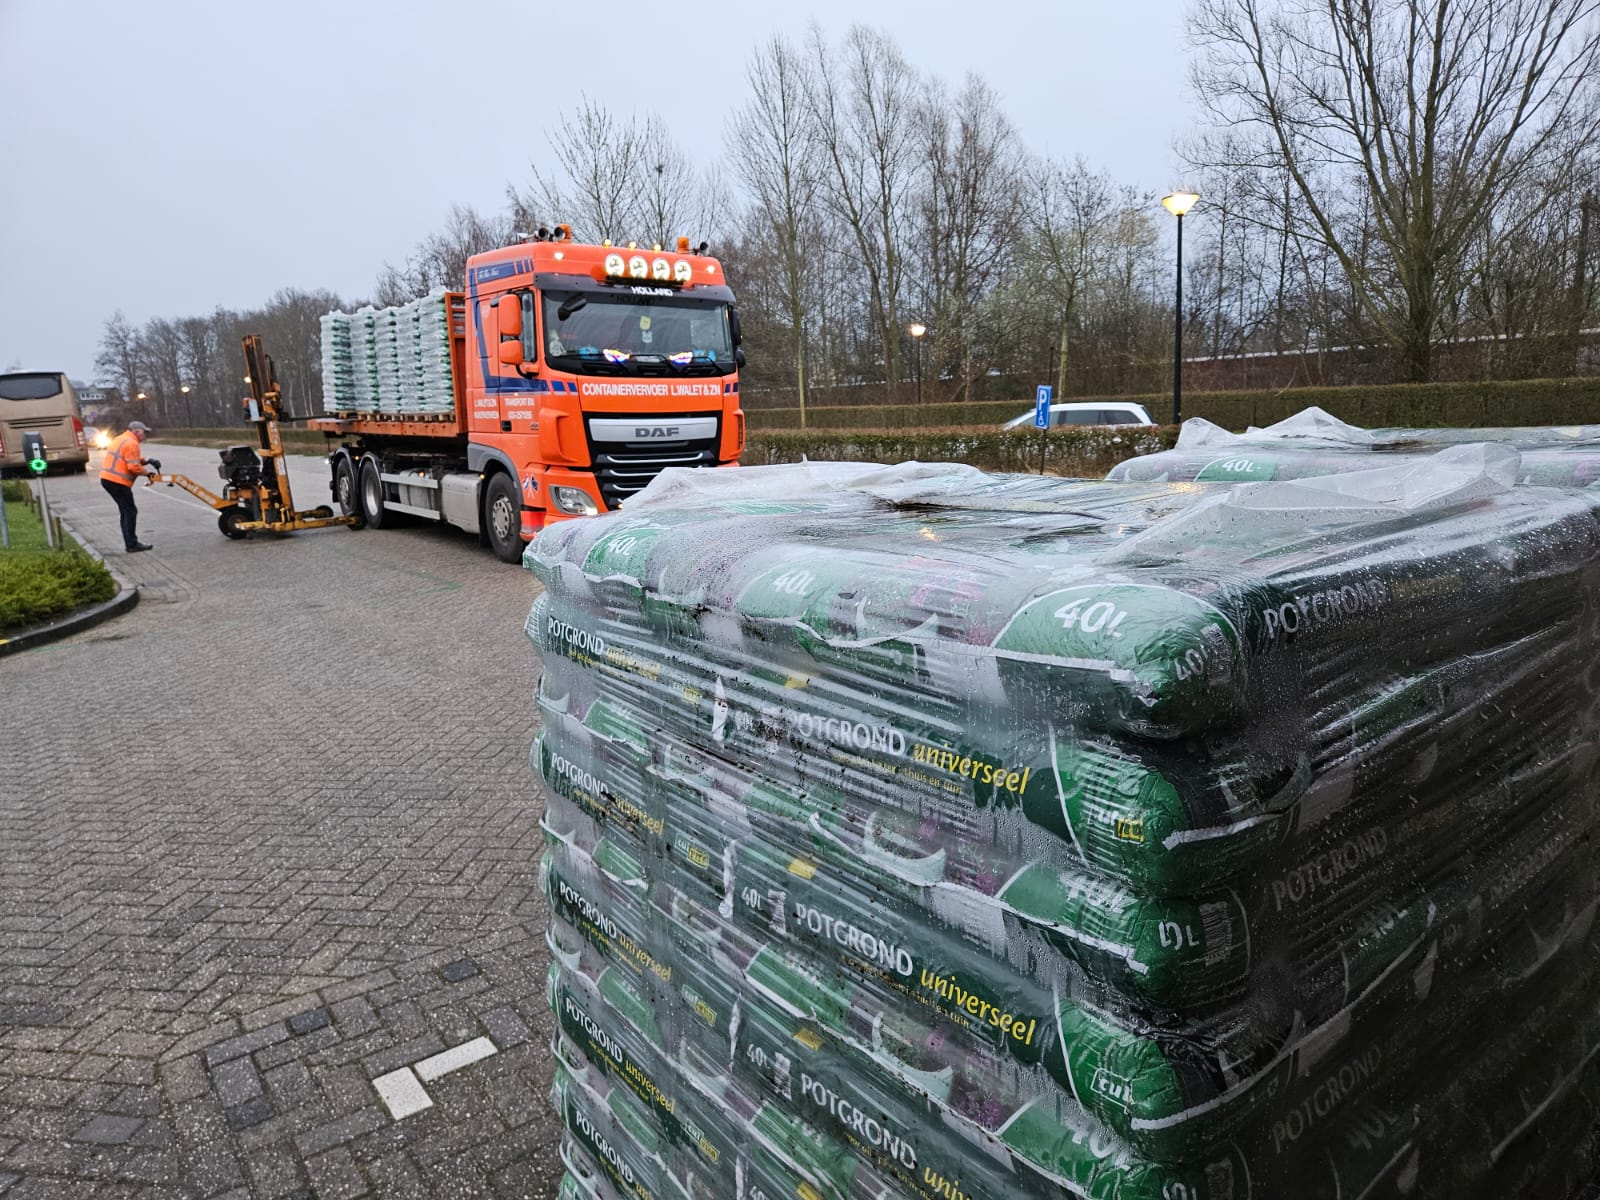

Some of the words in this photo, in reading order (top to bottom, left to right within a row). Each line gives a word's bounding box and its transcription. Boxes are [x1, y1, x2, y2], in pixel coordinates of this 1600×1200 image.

[631, 286, 674, 297] HOLLAND
[582, 383, 668, 396] CONTAINERVERVOER
[1039, 389, 1048, 411] P
[635, 427, 680, 438] DAF
[1222, 459, 1254, 473] 40L
[607, 536, 638, 556] 40L
[772, 569, 817, 596] 40L
[1054, 597, 1128, 639] 40L
[1263, 578, 1388, 640] POTGROND
[547, 617, 605, 656] POTGROND
[551, 752, 609, 800] POTGROND
[913, 743, 1031, 795] universeel
[1271, 826, 1388, 912] POTGROND
[559, 882, 617, 939] POTGROND
[619, 933, 672, 982] universeel
[795, 902, 914, 976] POTGROND
[920, 969, 1036, 1046] universeel
[565, 997, 623, 1063] POTGROND
[625, 1060, 676, 1114] universeel
[800, 1072, 917, 1171] POTGROND
[1271, 1044, 1382, 1155] POTGROND
[575, 1110, 634, 1183] POTGROND
